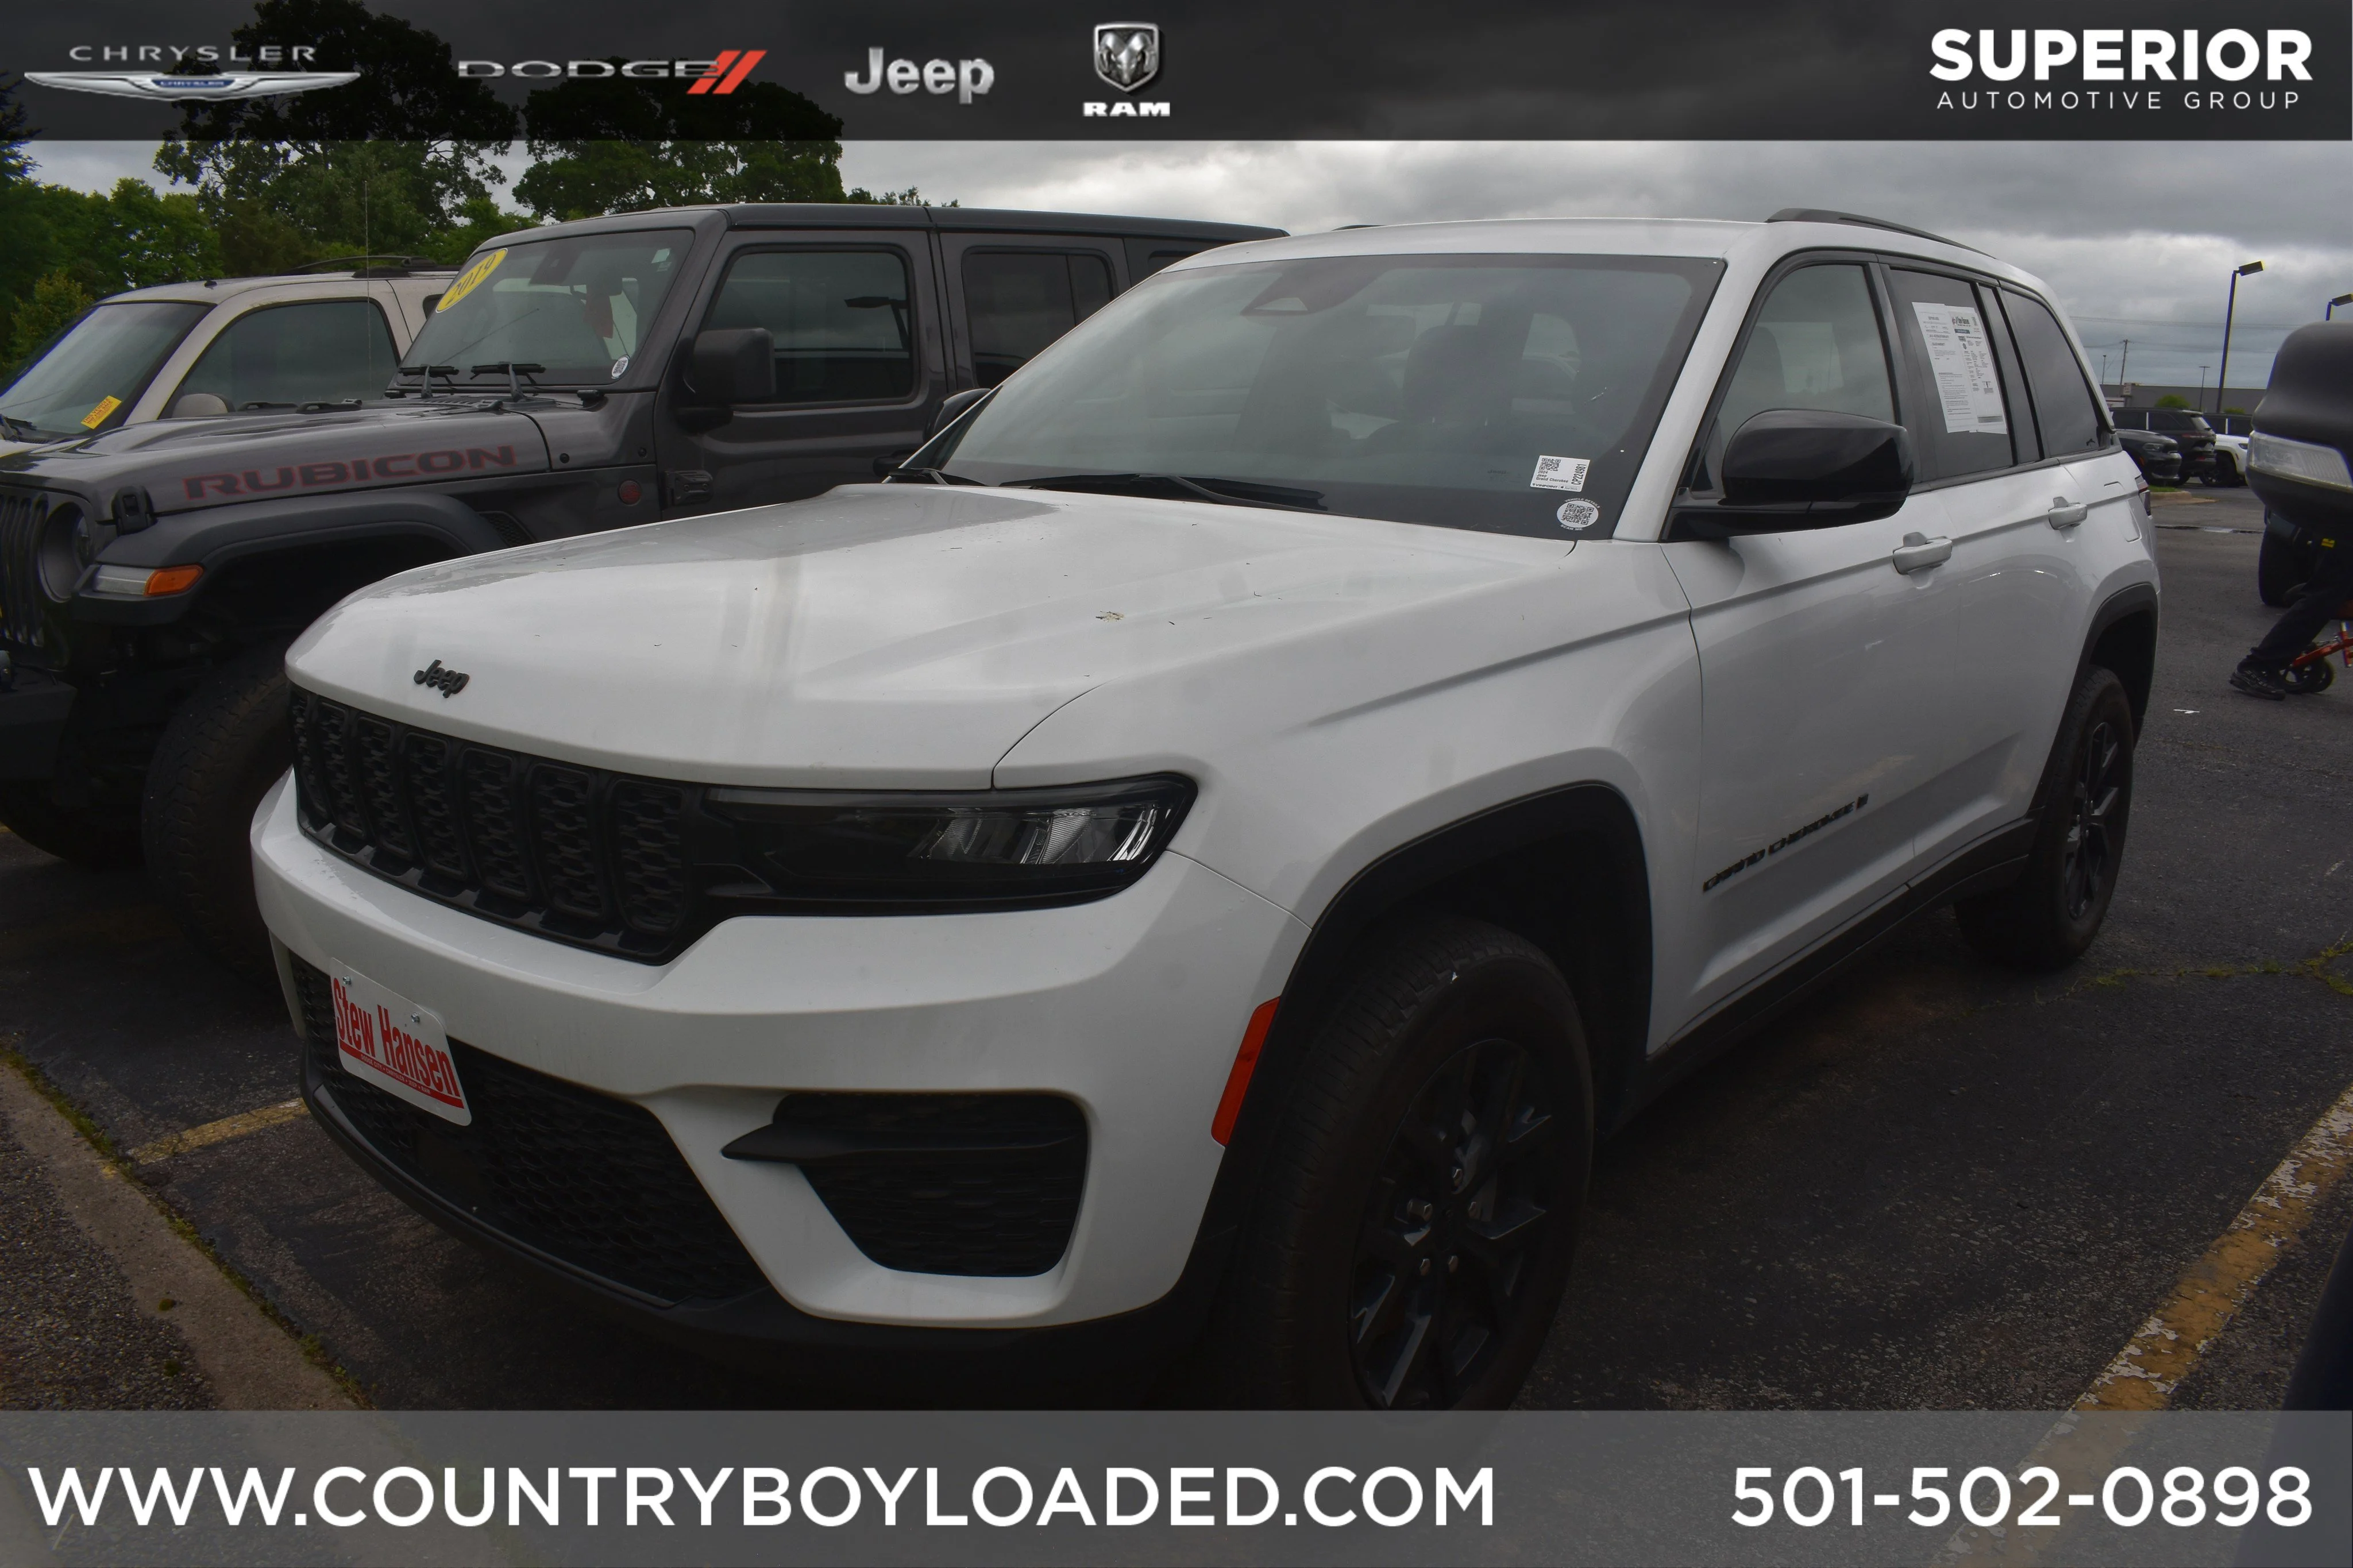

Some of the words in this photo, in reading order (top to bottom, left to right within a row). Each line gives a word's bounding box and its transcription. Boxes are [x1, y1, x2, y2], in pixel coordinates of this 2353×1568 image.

[182, 445, 519, 501] RUBICON
[413, 659, 470, 698] Jeep
[333, 978, 376, 1058] Stew
[377, 1004, 461, 1098] Hansen
